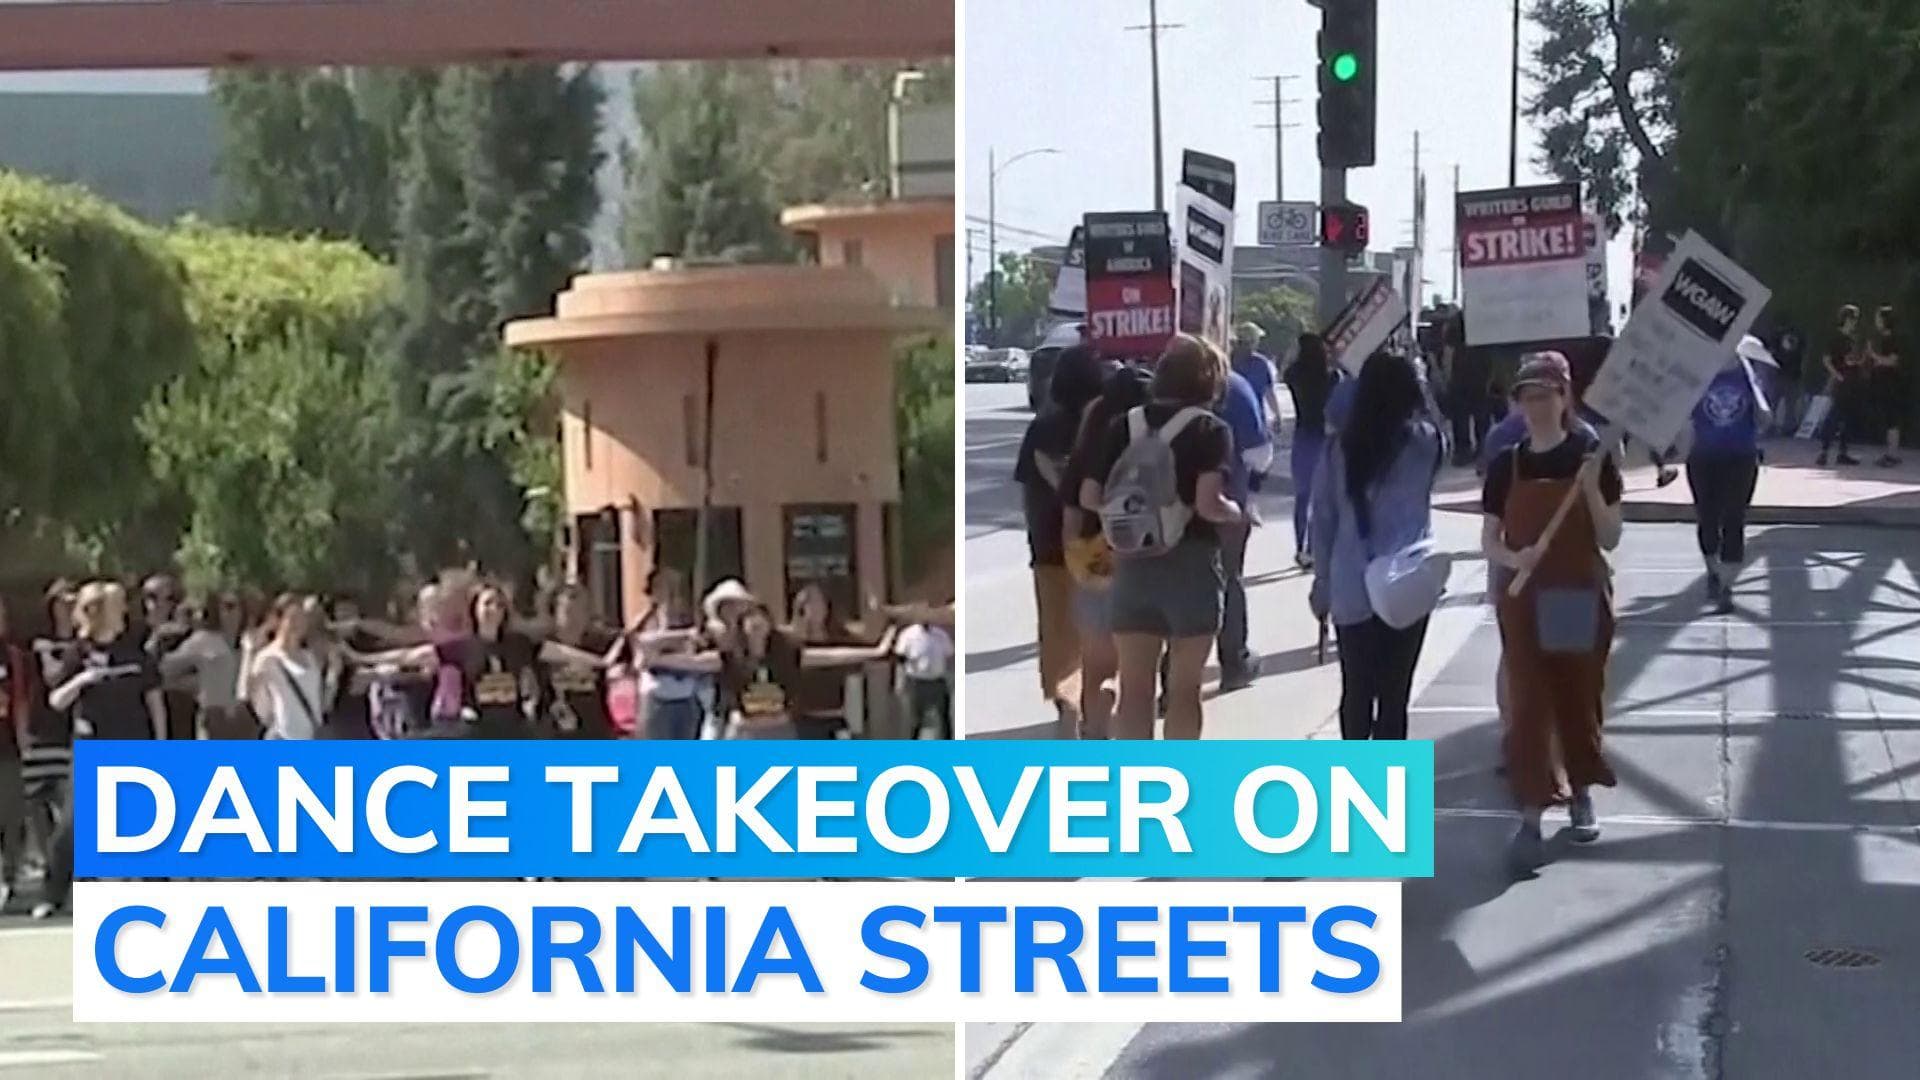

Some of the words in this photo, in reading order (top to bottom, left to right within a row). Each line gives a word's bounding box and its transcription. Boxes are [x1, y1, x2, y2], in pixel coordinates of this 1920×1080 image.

[1467, 223, 1576, 261] STRIKE!
[1672, 271, 1738, 327] WGAW
[1090, 304, 1172, 339] STRIKE!
